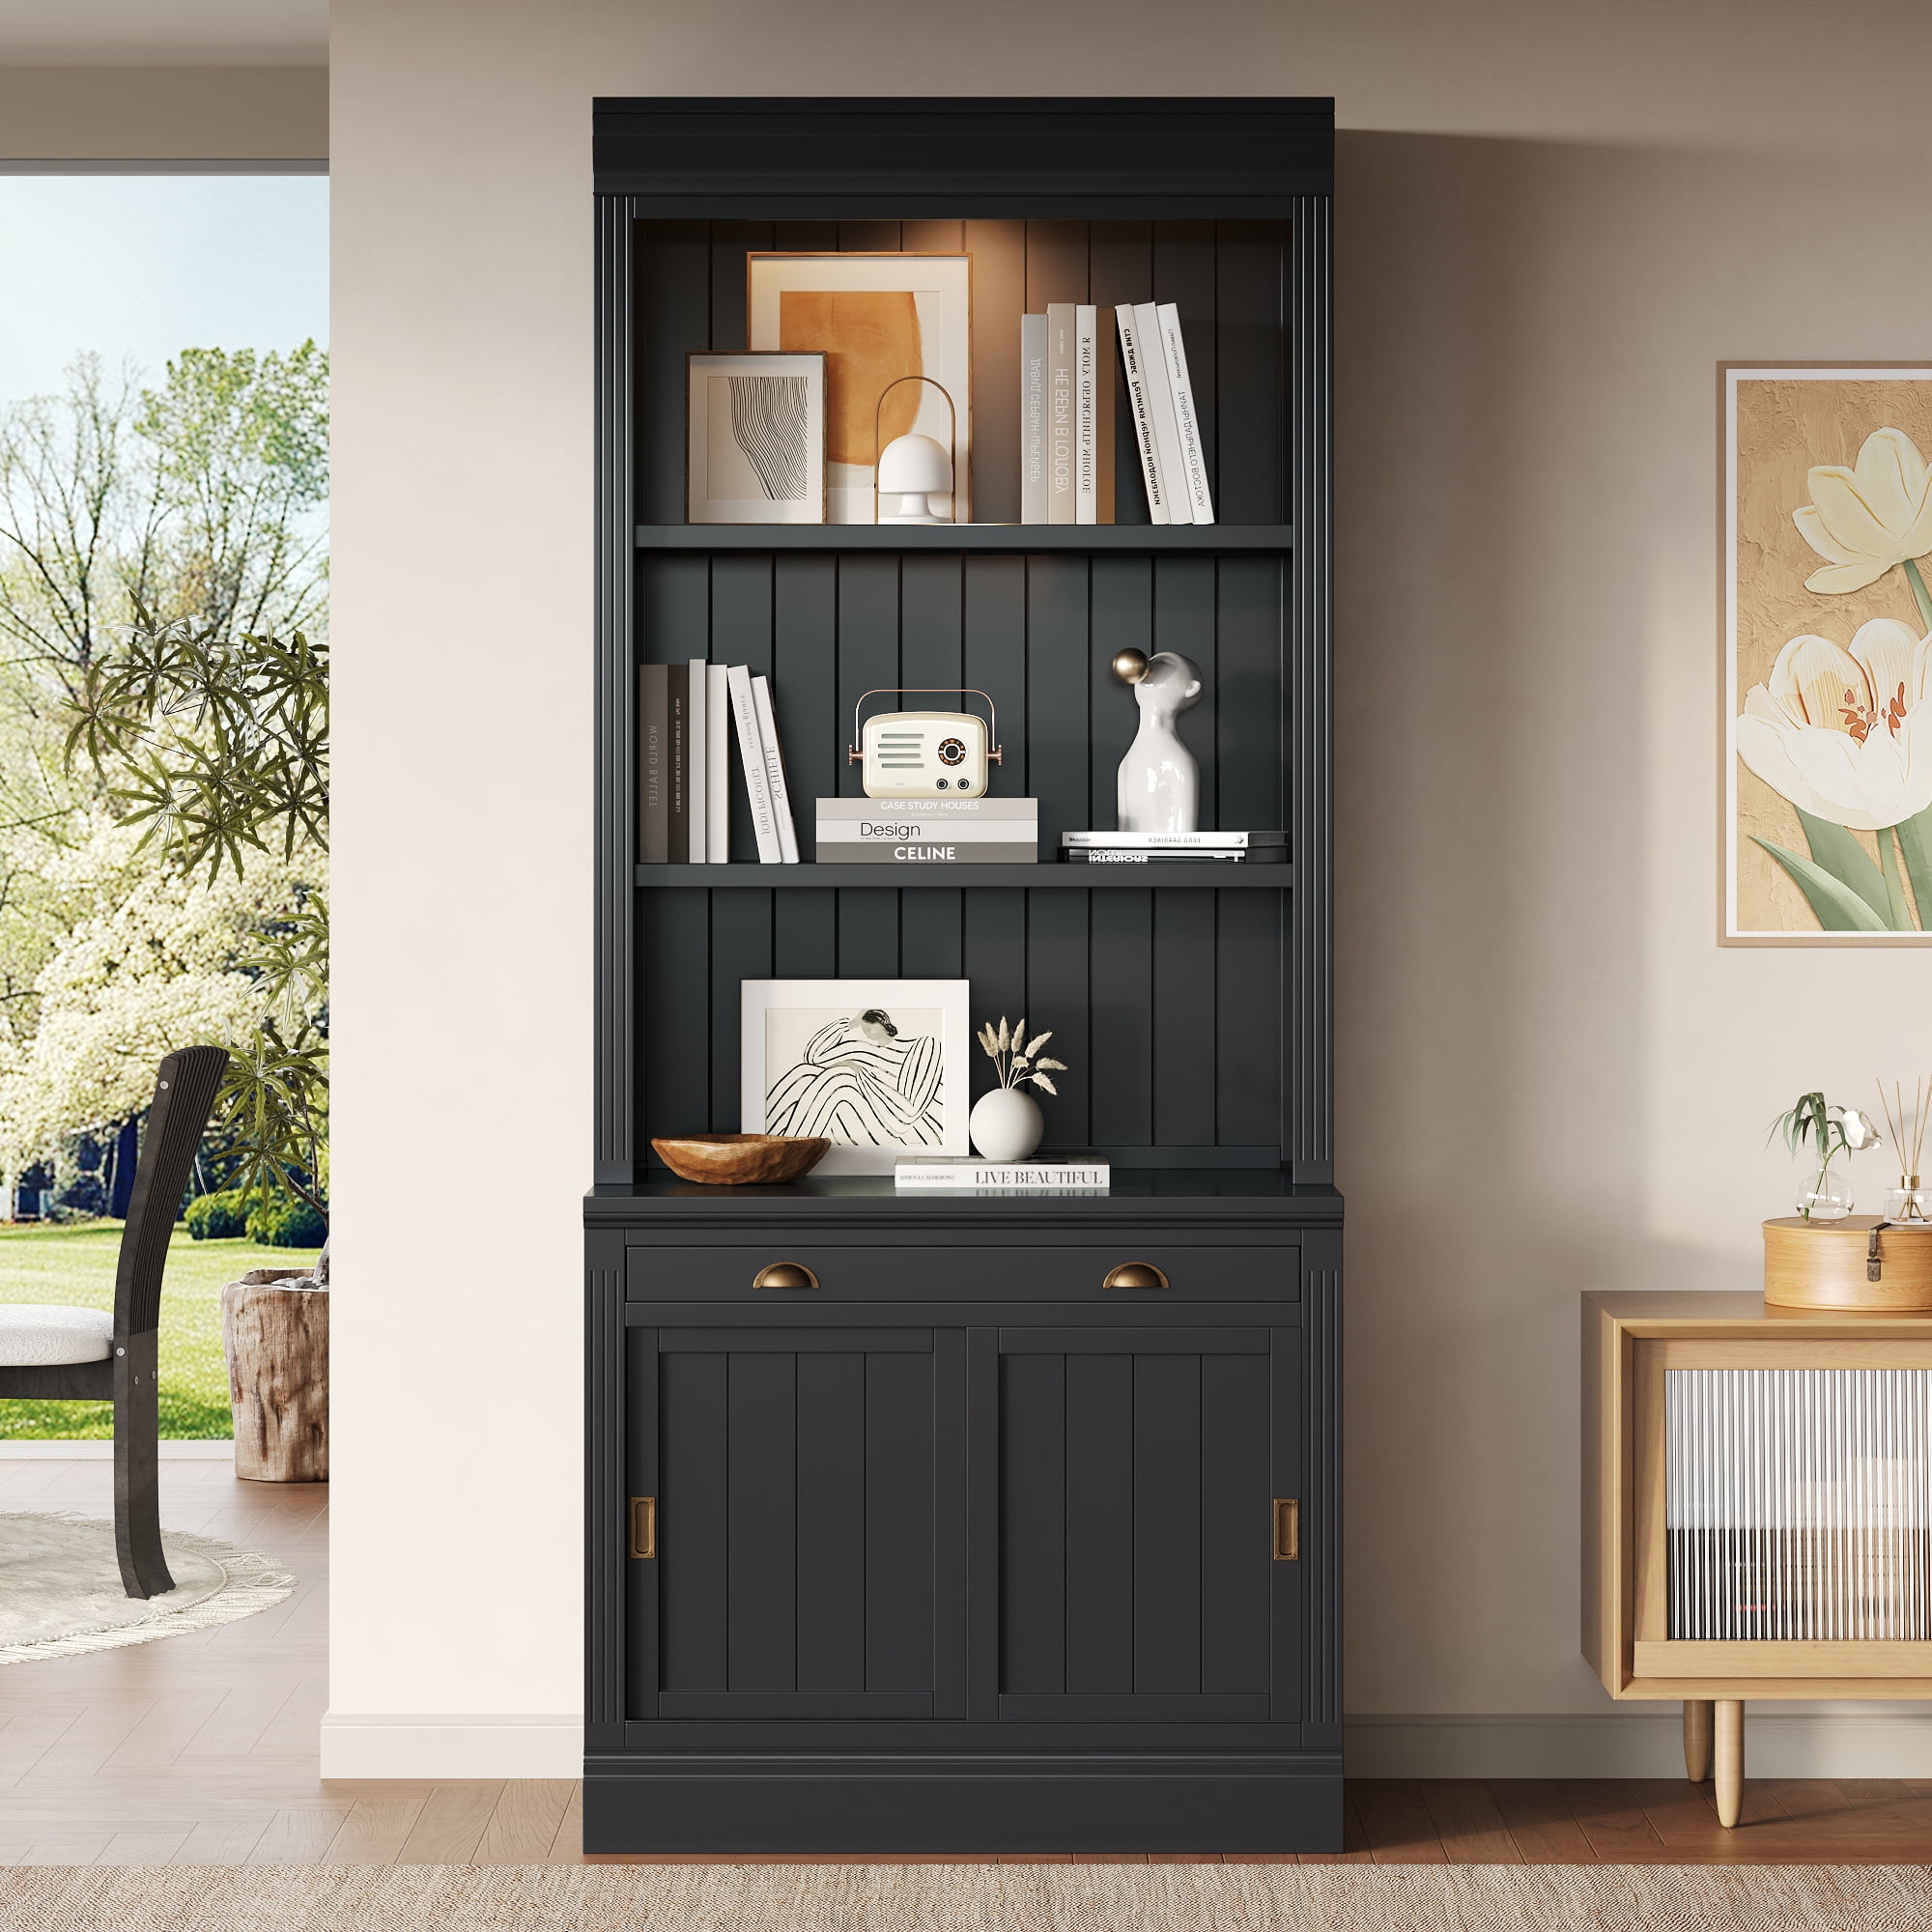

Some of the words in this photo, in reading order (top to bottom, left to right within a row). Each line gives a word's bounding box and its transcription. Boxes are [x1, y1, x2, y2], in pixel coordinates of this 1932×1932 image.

[880, 801, 906, 810] CASE
[908, 801, 939, 810] STUDY
[941, 801, 980, 810] HOUSES
[861, 822, 921, 840] Design
[894, 846, 956, 861] CELINE
[976, 1171, 1010, 1184] LIVE
[1014, 1171, 1103, 1184] BEAUTIFUL
